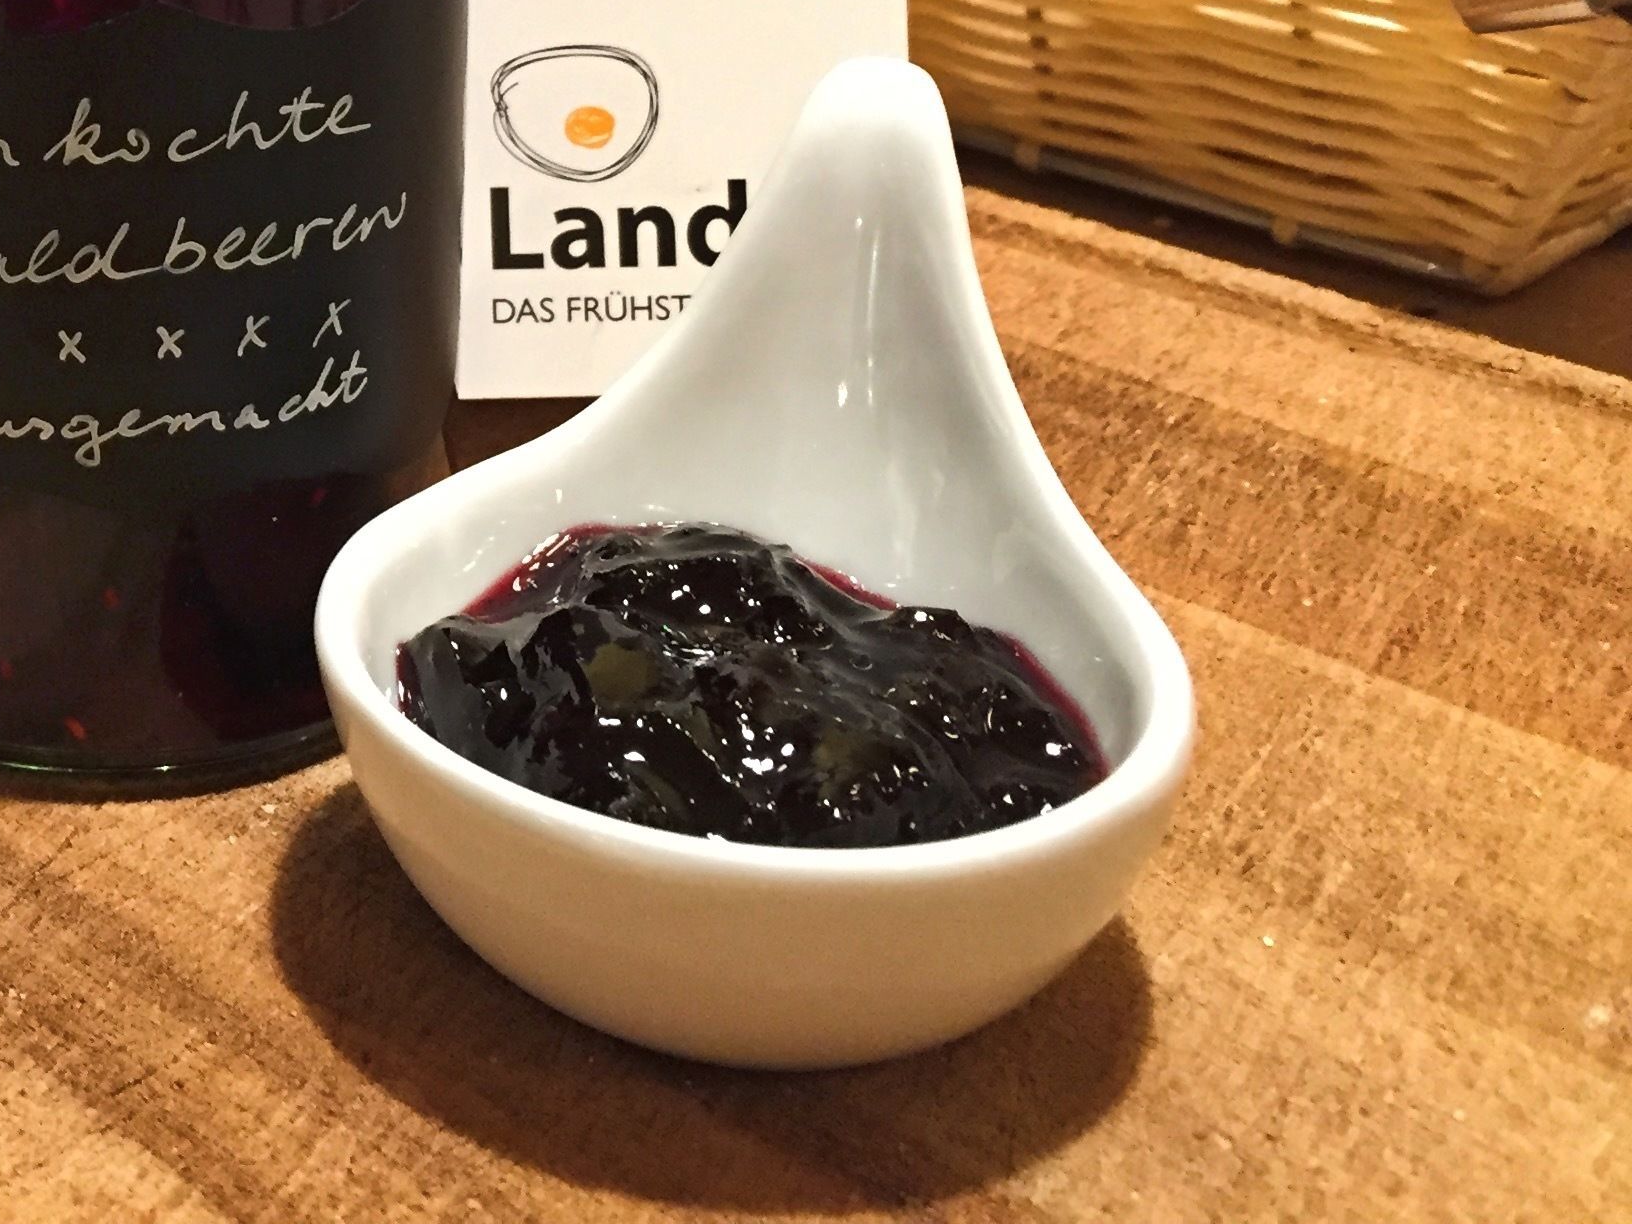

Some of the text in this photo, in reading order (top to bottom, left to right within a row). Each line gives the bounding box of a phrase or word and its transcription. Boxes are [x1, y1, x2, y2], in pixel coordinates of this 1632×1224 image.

[489, 178, 748, 271] Land
[491, 291, 694, 325] DAS FRÜHST
